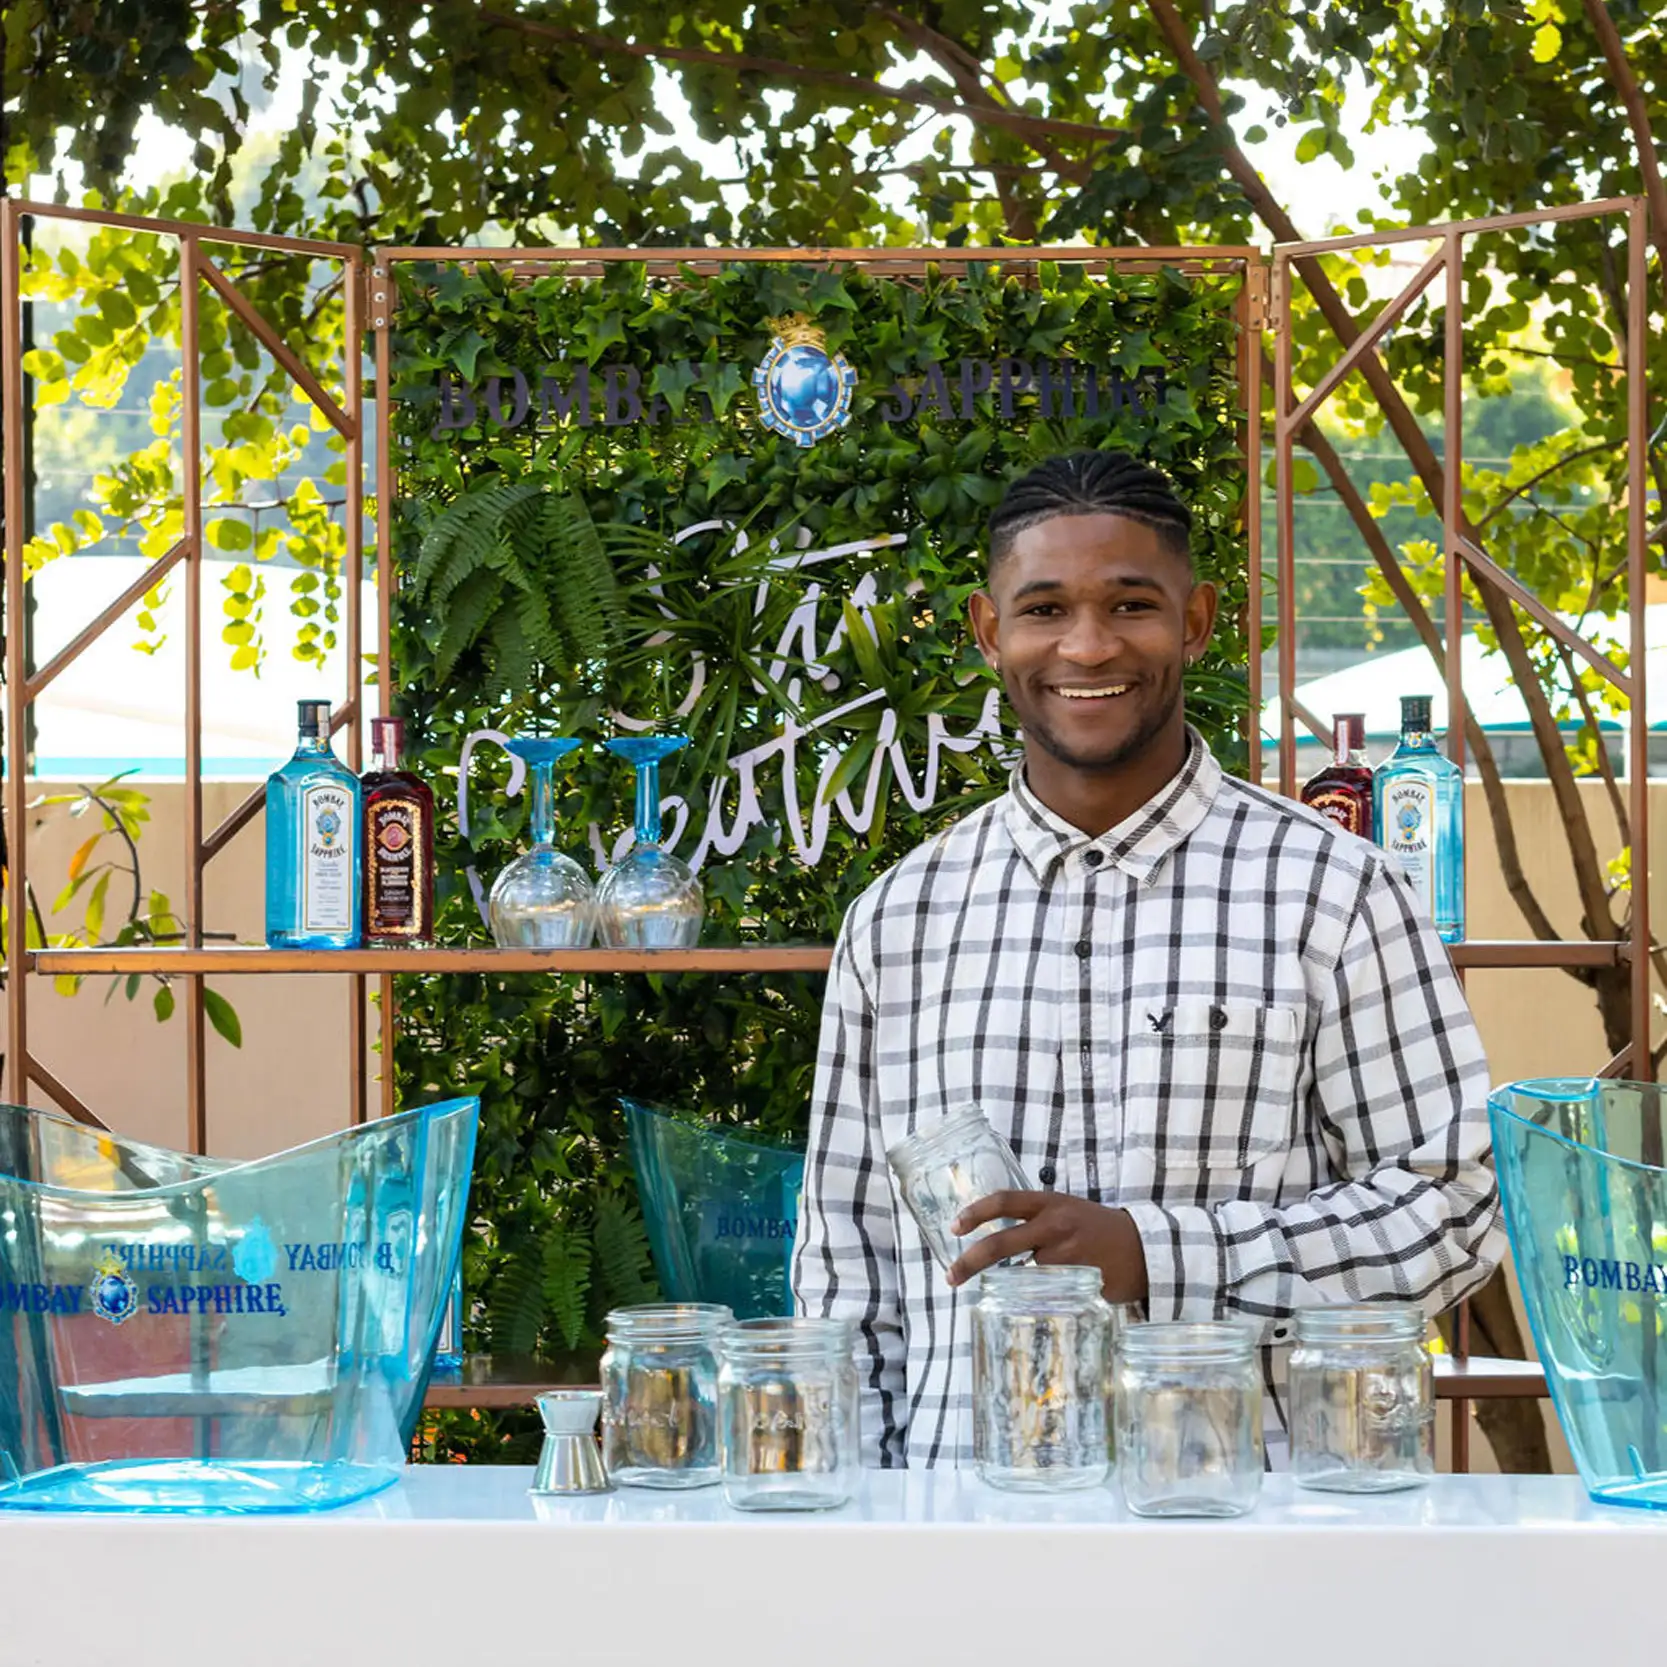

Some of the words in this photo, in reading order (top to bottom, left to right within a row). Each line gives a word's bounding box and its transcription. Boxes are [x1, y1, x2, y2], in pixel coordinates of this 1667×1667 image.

[715, 1217, 798, 1240] BOMBA
[0, 1281, 84, 1313] MBAY
[147, 1283, 287, 1317] SAPPHIRE
